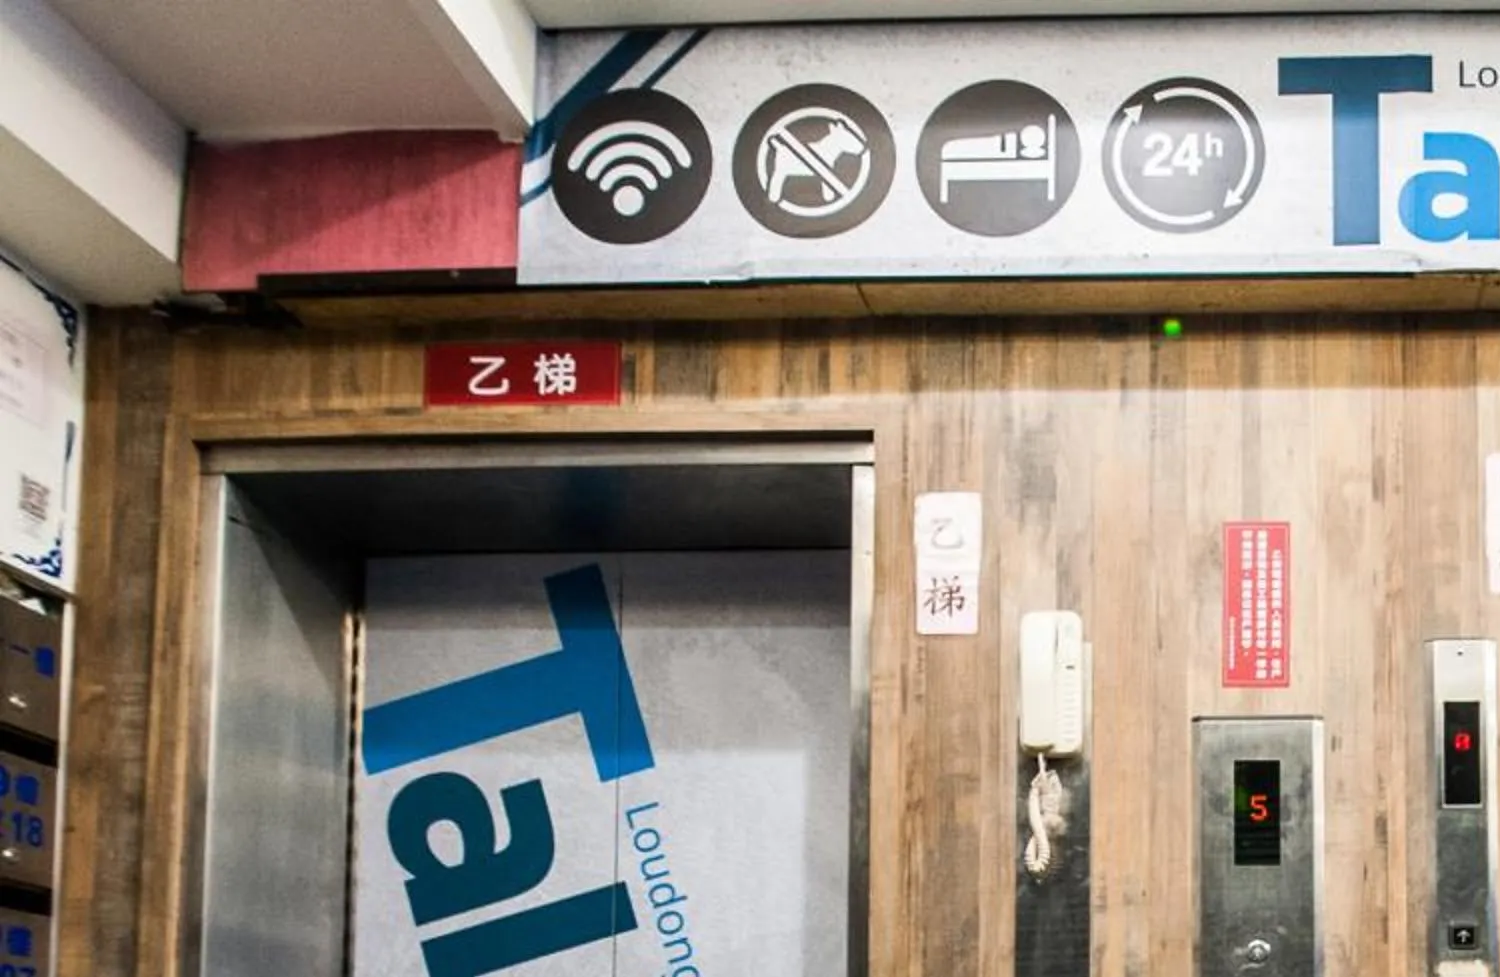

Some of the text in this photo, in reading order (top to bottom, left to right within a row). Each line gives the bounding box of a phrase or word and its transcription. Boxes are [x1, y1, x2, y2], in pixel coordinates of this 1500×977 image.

[1142, 131, 1224, 177] 24h
[467, 353, 578, 396] 乙梯
[923, 517, 966, 618] 乙梯
[1249, 793, 1268, 821] 5
